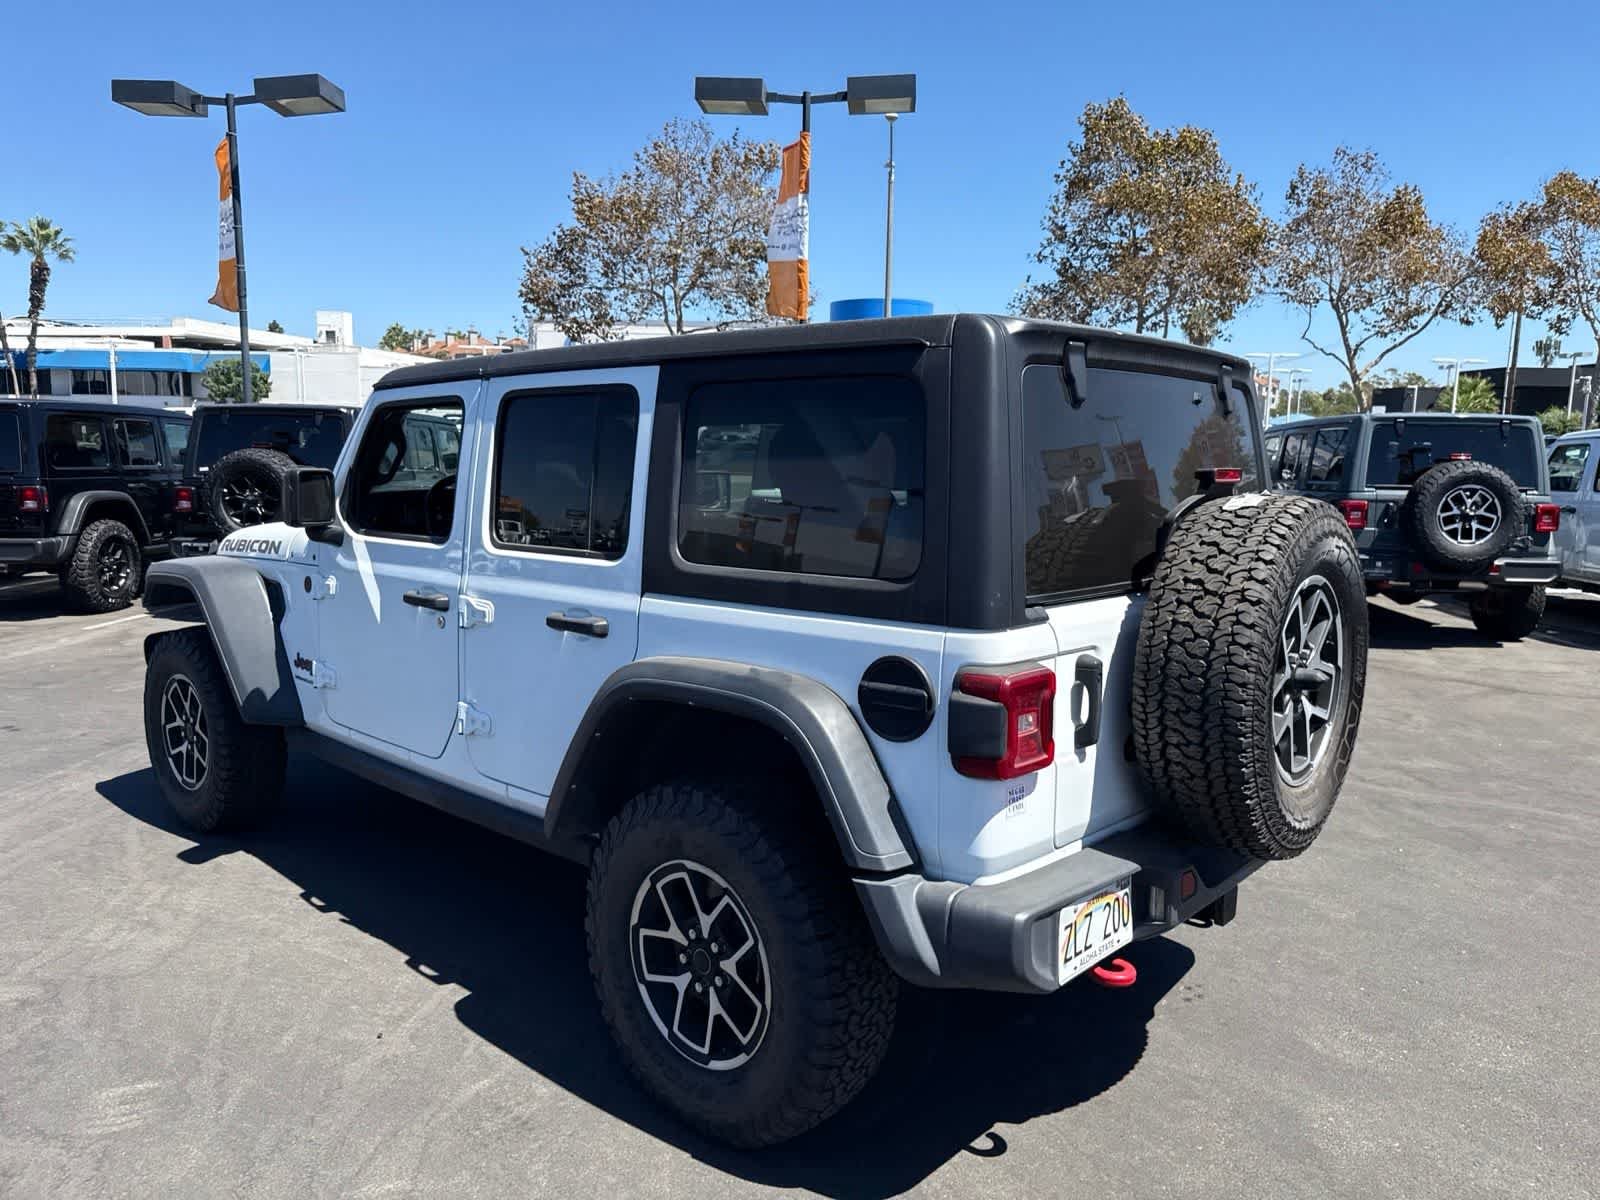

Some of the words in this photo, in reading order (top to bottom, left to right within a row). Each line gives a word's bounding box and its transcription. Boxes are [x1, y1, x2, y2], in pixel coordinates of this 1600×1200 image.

[221, 539, 282, 554] RUBICON
[1063, 911, 1093, 965] ZLZ
[1103, 892, 1130, 940] 200
[1080, 950, 1098, 966] ALOHA
[1098, 939, 1115, 956] STATE
